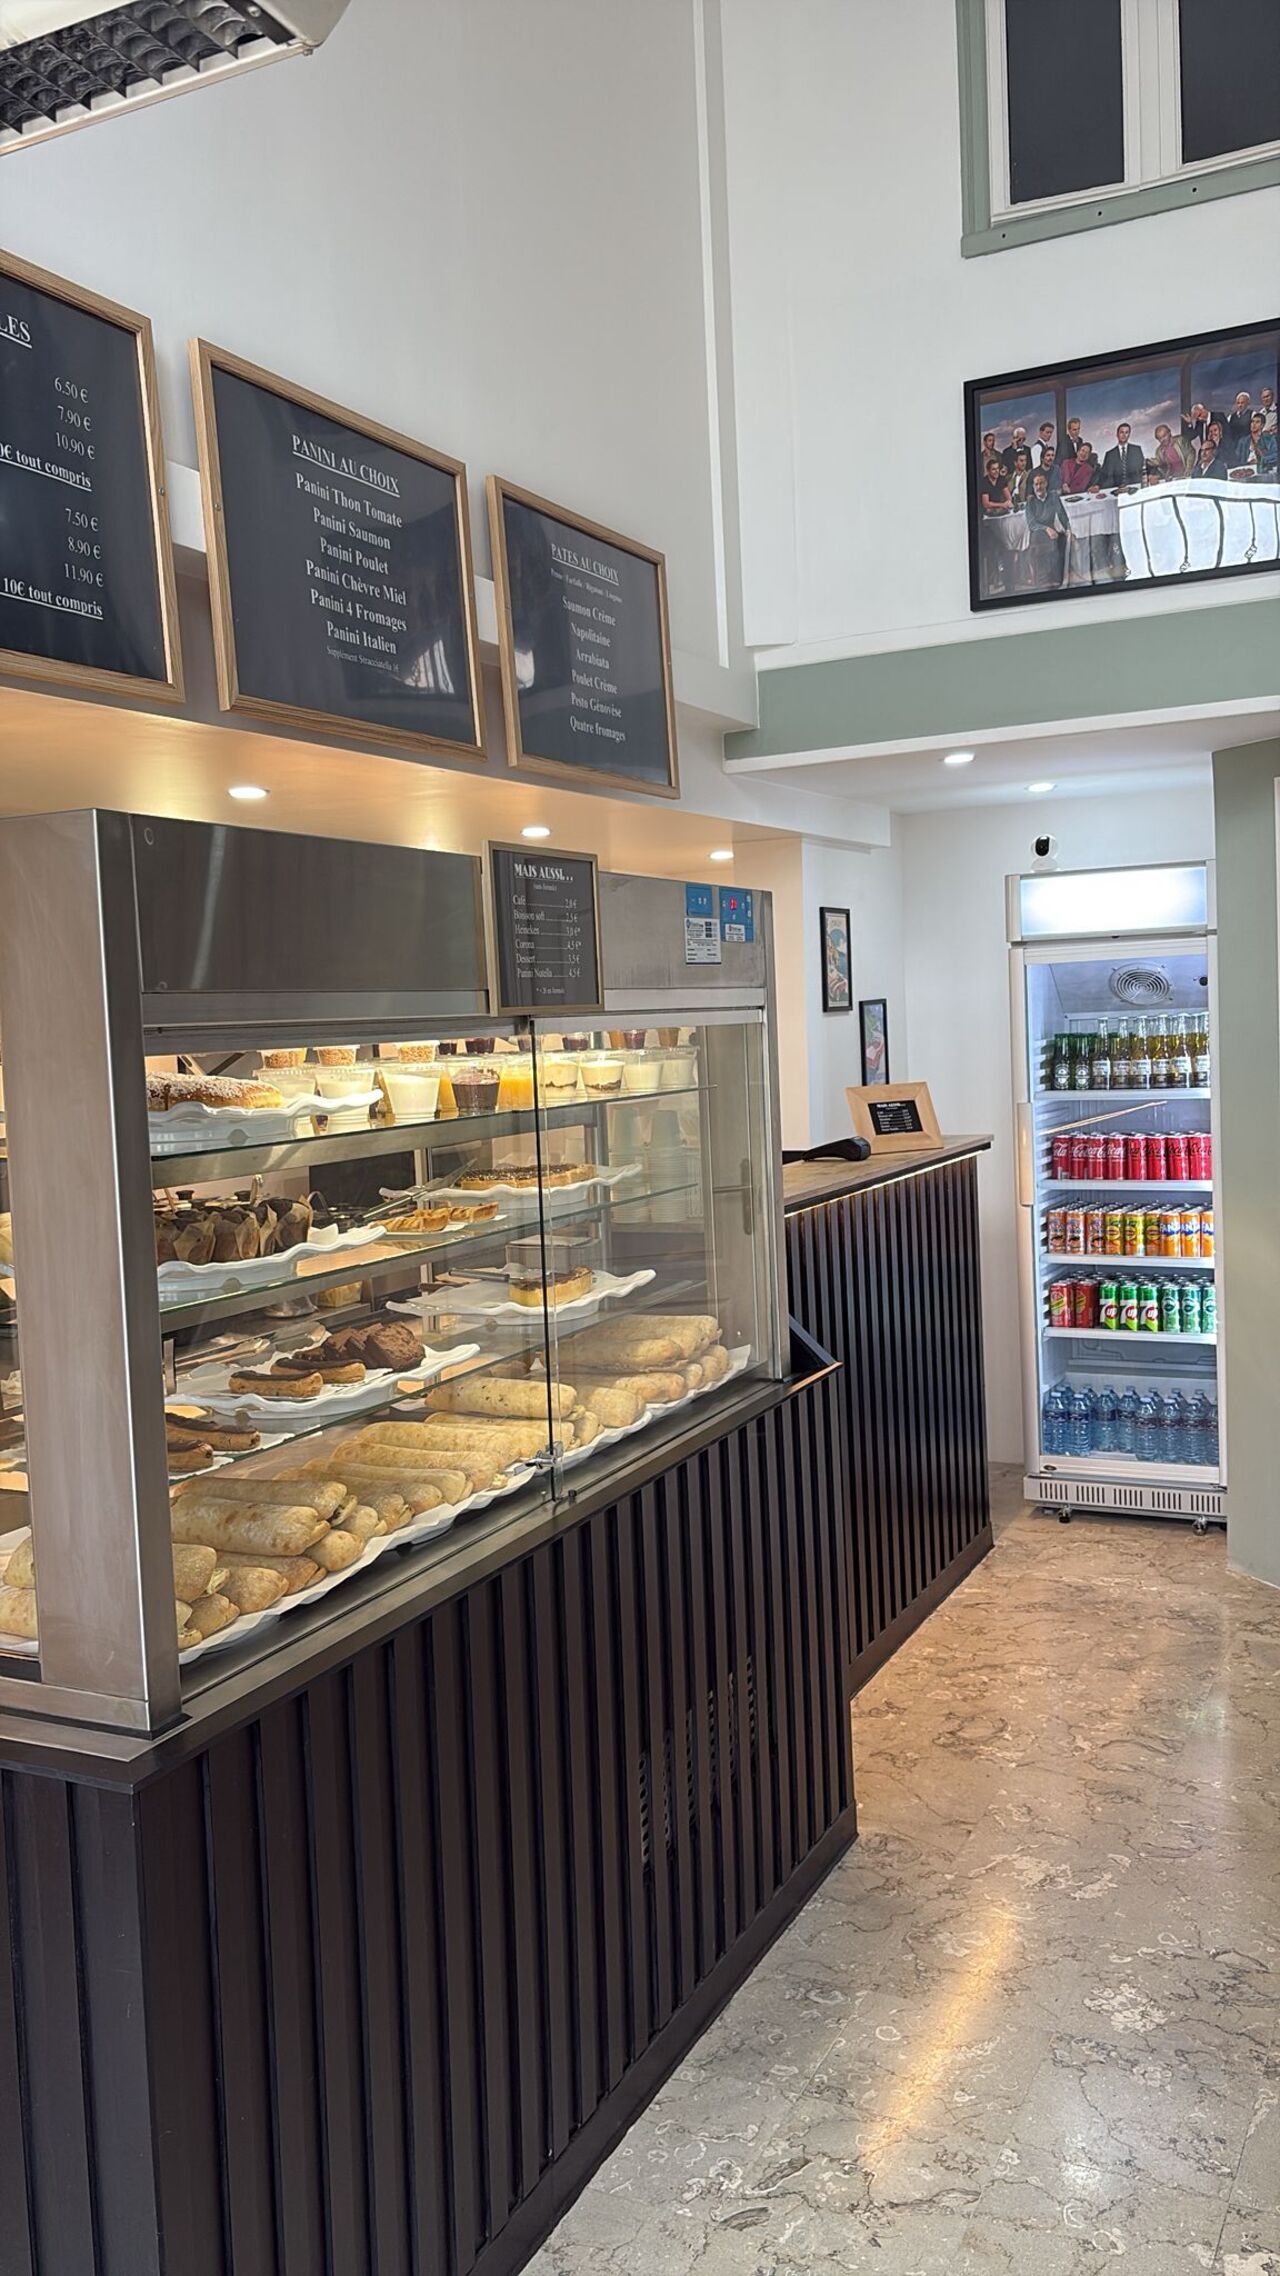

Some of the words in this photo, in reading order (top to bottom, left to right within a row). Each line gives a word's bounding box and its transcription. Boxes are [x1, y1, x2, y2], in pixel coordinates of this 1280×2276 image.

[55, 377, 78, 399] 6.50
[81, 388, 89, 404] €
[57, 405, 81, 428] 7.90
[83, 416, 92, 432] €
[56, 432, 85, 457] 10.90
[88, 444, 96, 460] €
[16, 450, 42, 471] tout
[45, 460, 92, 488] compris
[292, 434, 336, 468] PANINI
[340, 457, 358, 476] AU
[360, 465, 400, 494] CHOIX
[296, 472, 330, 501] Panini
[332, 488, 362, 513] Thon
[363, 500, 403, 528] Tomate
[65, 508, 89, 530] 7.50
[90, 517, 99, 532] €
[313, 506, 346, 535] Panini
[348, 521, 391, 550] Saumon
[68, 536, 91, 557] 8.90
[93, 545, 102, 560] €
[320, 536, 353, 563] Panini
[355, 550, 389, 575] Poulet
[551, 543, 579, 565] PATES
[580, 556, 592, 571] AU
[593, 561, 620, 583] CHOIX
[64, 563, 94, 585] 11.90
[95, 572, 104, 588] €
[306, 559, 340, 586] Panini
[342, 573, 381, 599] Chèvre
[383, 584, 407, 606] Miel
[3, 577, 26, 597] 10€
[28, 586, 53, 604] tout
[55, 594, 103, 618] compris
[311, 588, 344, 614] Panini
[346, 600, 353, 616] 4
[355, 603, 407, 632] Fromages
[562, 595, 591, 617] Saumon
[592, 607, 617, 626] Crème
[327, 621, 360, 646] Panini
[362, 631, 397, 655] Italien
[571, 622, 611, 647] Napolitaine
[571, 669, 593, 688] Poulet
[570, 716, 595, 734] Quatre
[514, 863, 538, 878] MAIS
